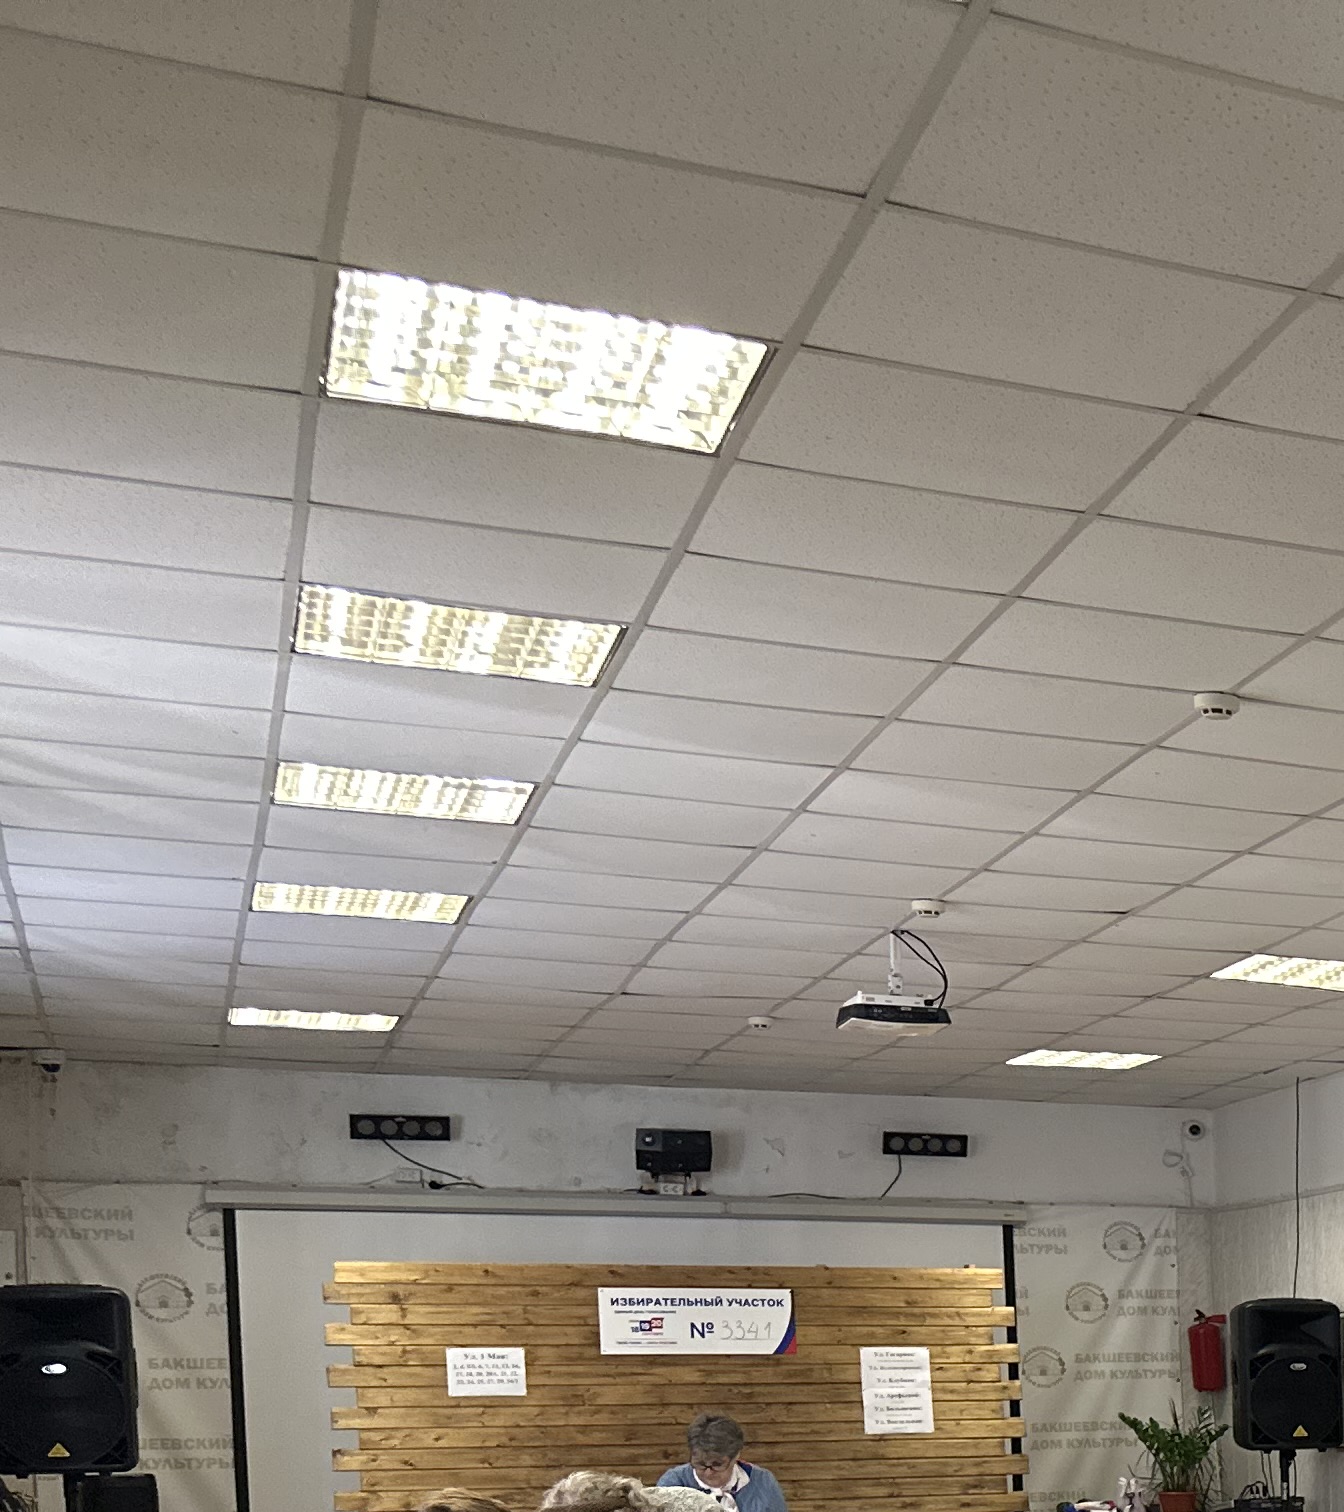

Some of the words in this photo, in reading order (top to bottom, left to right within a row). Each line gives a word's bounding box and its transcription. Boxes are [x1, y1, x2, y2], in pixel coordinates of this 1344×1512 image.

[610, 1296, 723, 1307] ИЗБИРАТЕЛЬНЫЙ
[726, 1298, 784, 1307] УЧАСТОК
[690, 1322, 714, 1338] №
[720, 1320, 772, 1340] 3341
[1031, 1421, 1132, 1433] БАКШЕЕВСКИ
